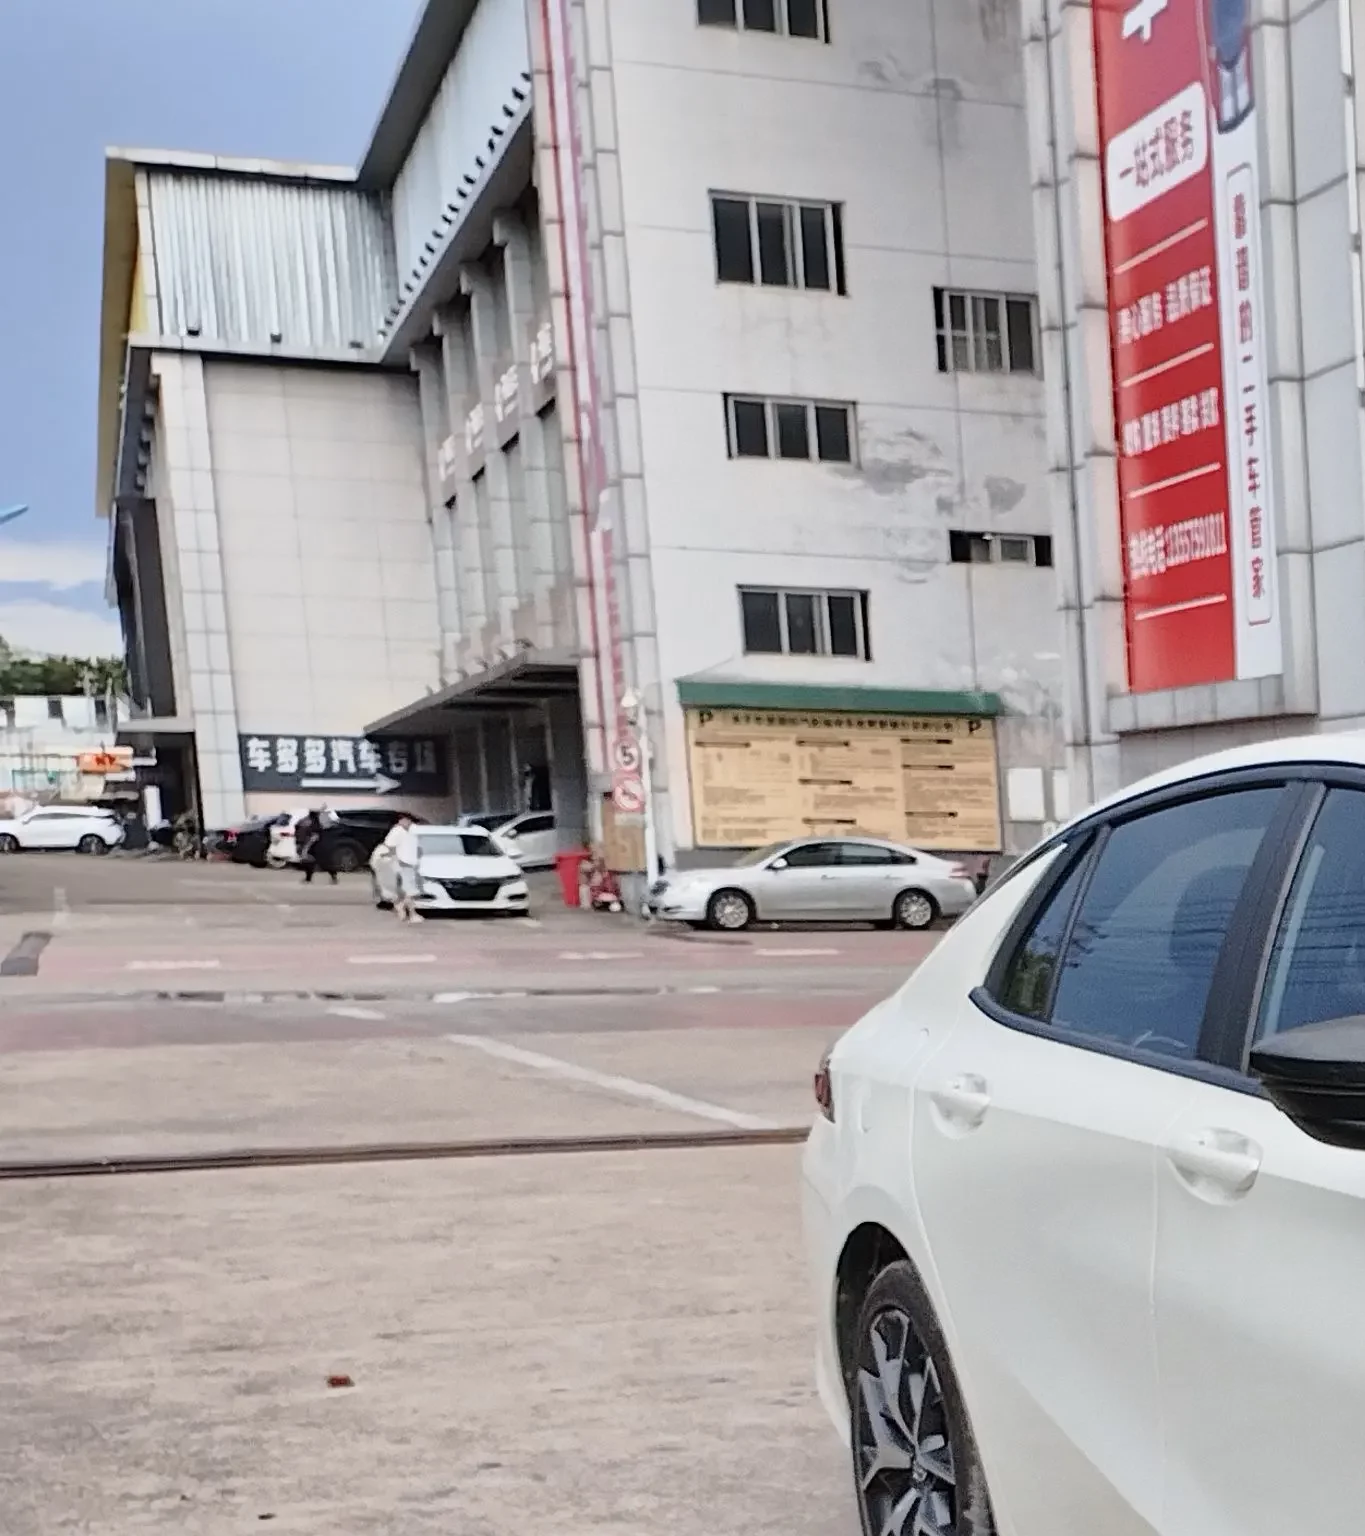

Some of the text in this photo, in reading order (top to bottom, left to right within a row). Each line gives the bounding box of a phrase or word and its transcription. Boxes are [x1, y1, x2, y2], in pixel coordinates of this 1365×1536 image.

[1119, 109, 1194, 187] 一站式服务
[621, 744, 635, 766] 5
